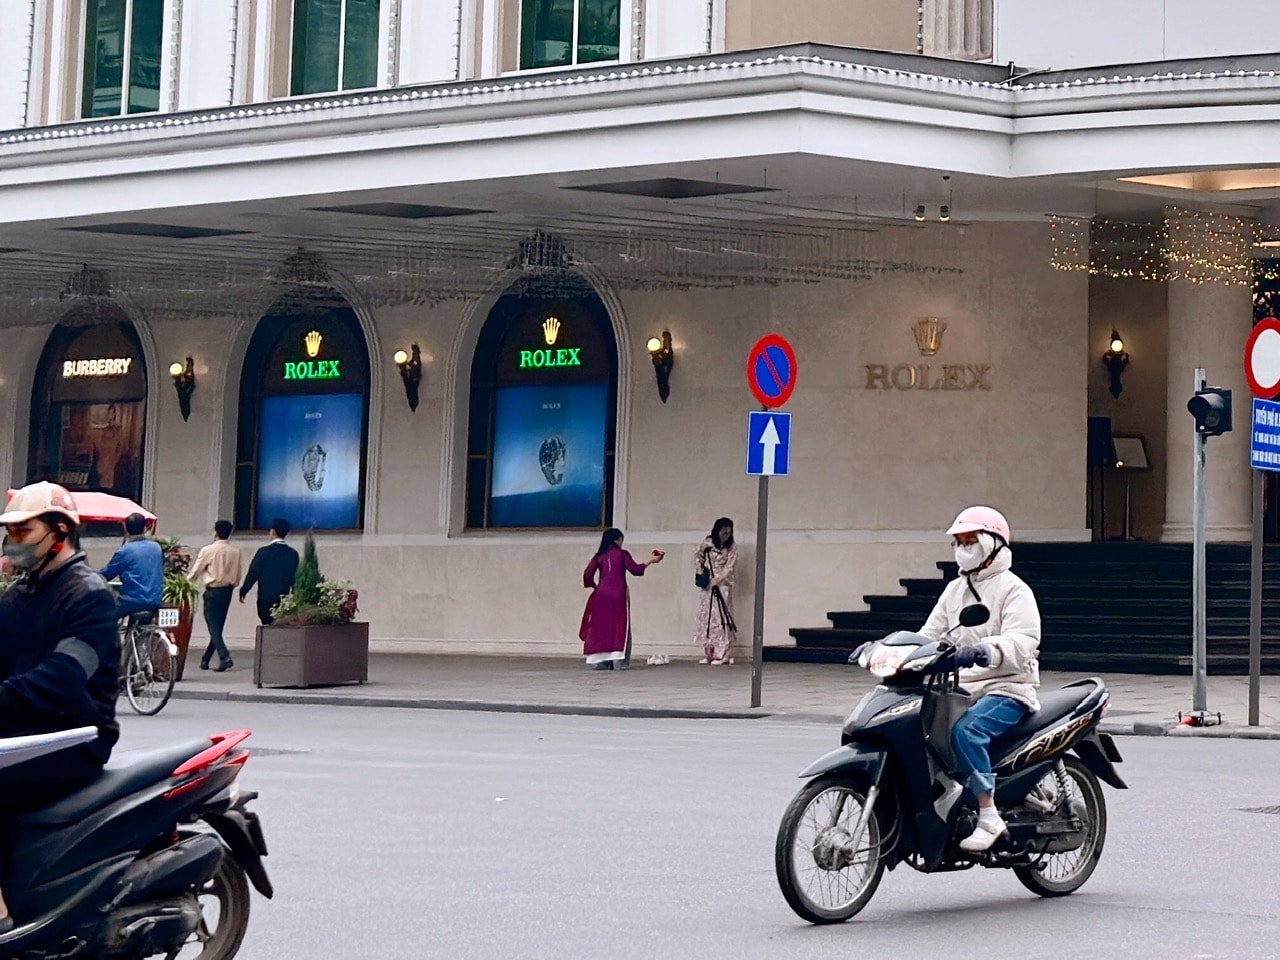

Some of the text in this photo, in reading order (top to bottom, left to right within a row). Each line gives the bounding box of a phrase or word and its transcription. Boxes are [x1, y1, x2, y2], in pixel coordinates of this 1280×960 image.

[63, 358, 131, 377] BURBERRY
[519, 348, 581, 368] ROLEX
[284, 360, 340, 379] ROLEX
[864, 363, 992, 390] ROLEX
